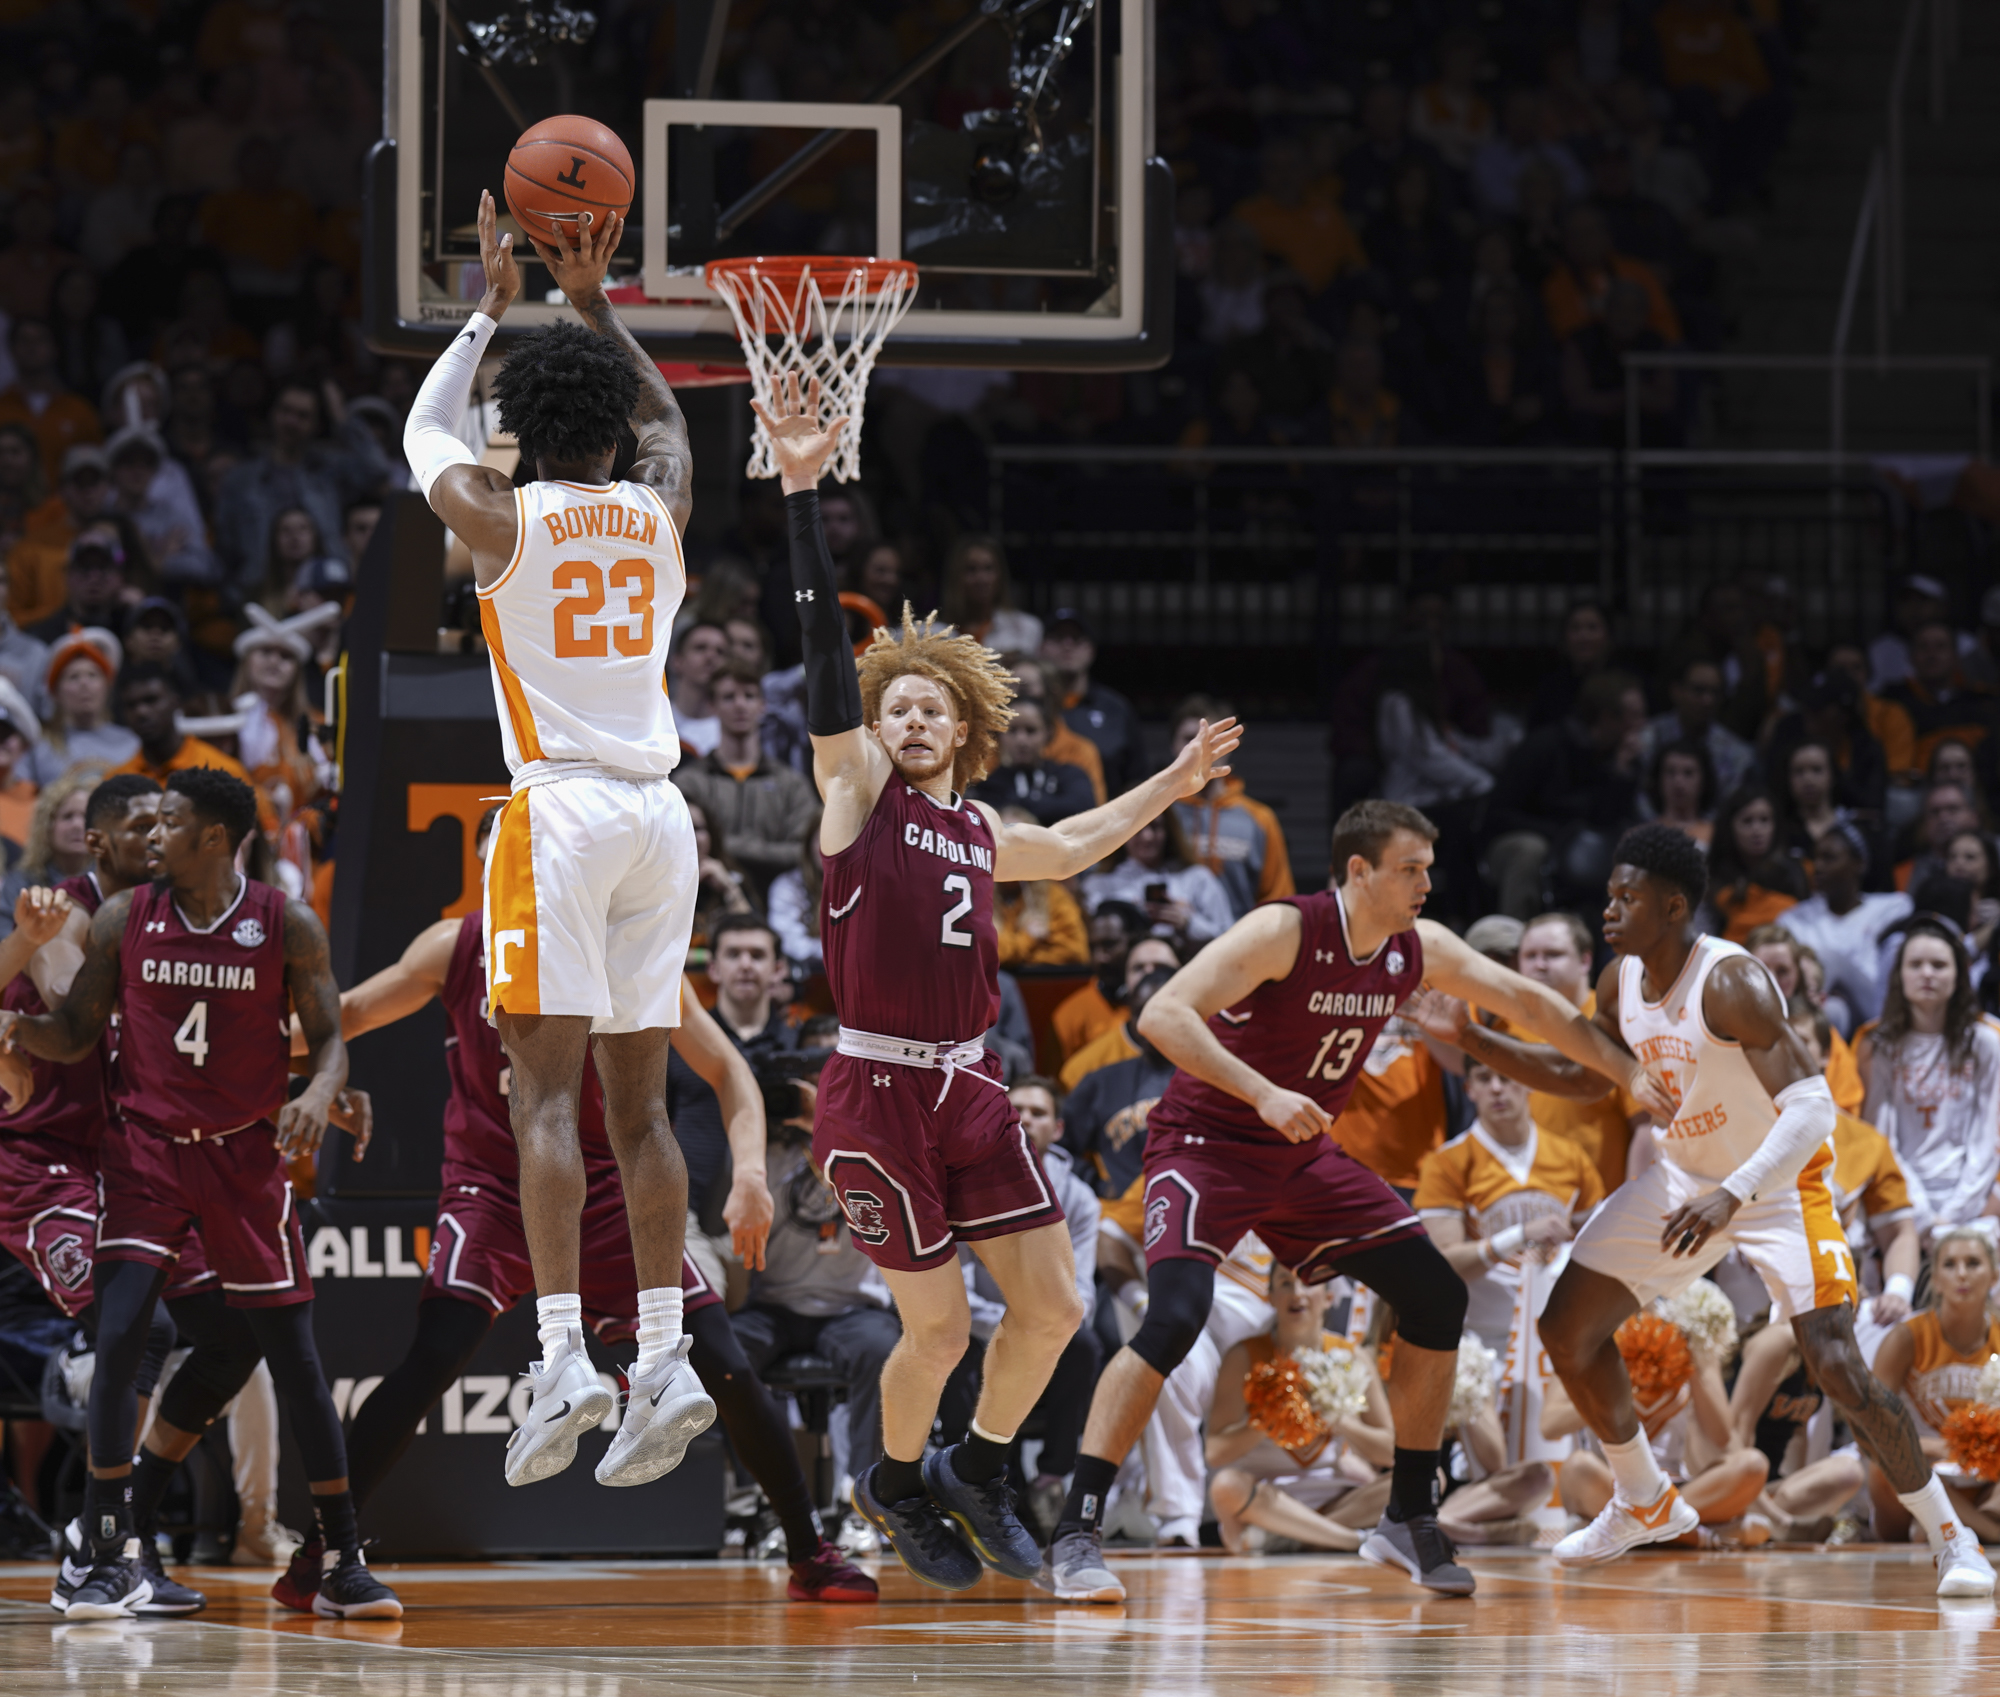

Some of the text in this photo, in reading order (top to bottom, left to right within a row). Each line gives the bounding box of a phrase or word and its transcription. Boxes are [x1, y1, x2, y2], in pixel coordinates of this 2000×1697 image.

[556, 156, 587, 190] T
[542, 504, 658, 546] BOWDEN
[553, 558, 654, 658] 23
[905, 822, 992, 875] CAROLINA
[940, 873, 973, 948] 2
[142, 958, 256, 991] CAROLINA
[1308, 990, 1396, 1018] CAROLINA
[174, 1001, 209, 1067] 4
[1306, 1027, 1364, 1080] 13
[1817, 1239, 1852, 1282] T
